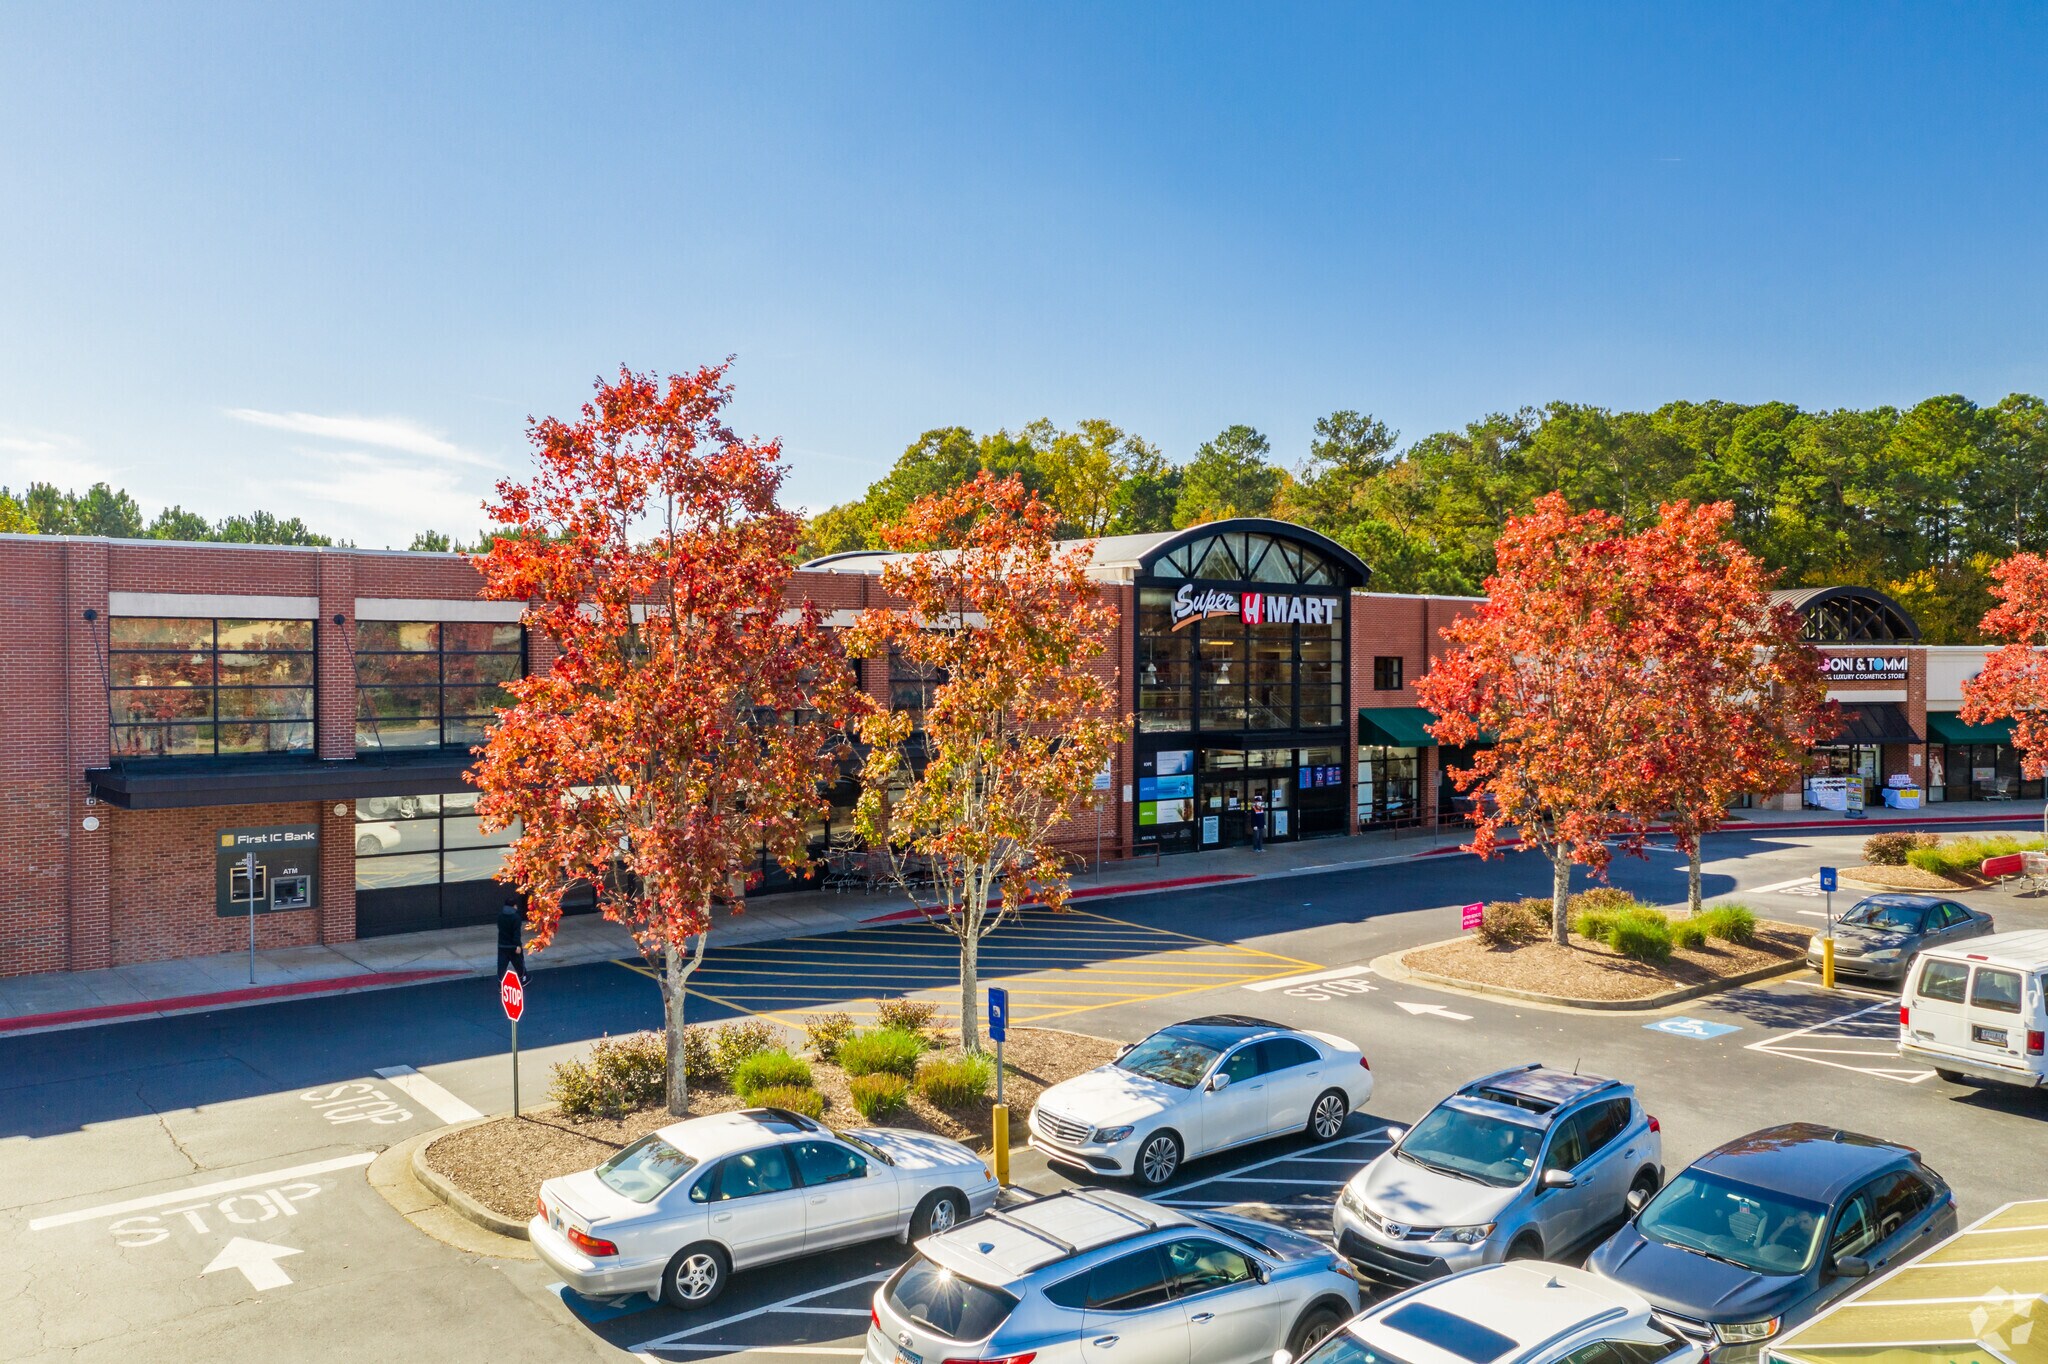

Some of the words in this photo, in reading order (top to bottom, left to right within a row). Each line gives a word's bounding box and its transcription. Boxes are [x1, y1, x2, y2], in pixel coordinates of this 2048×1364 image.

[1177, 584, 1235, 619] Super
[1244, 593, 1261, 624] H
[1267, 596, 1337, 625] MART
[1856, 658, 1866, 671] &
[1867, 657, 1908, 671] TOMMI
[238, 834, 267, 844] First
[270, 833, 282, 842] IC
[284, 831, 315, 841] Bank
[503, 984, 522, 1007] STOP
[1283, 978, 1379, 1001] STOP
[300, 1083, 413, 1125] STOP
[108, 1182, 322, 1248] STOP
